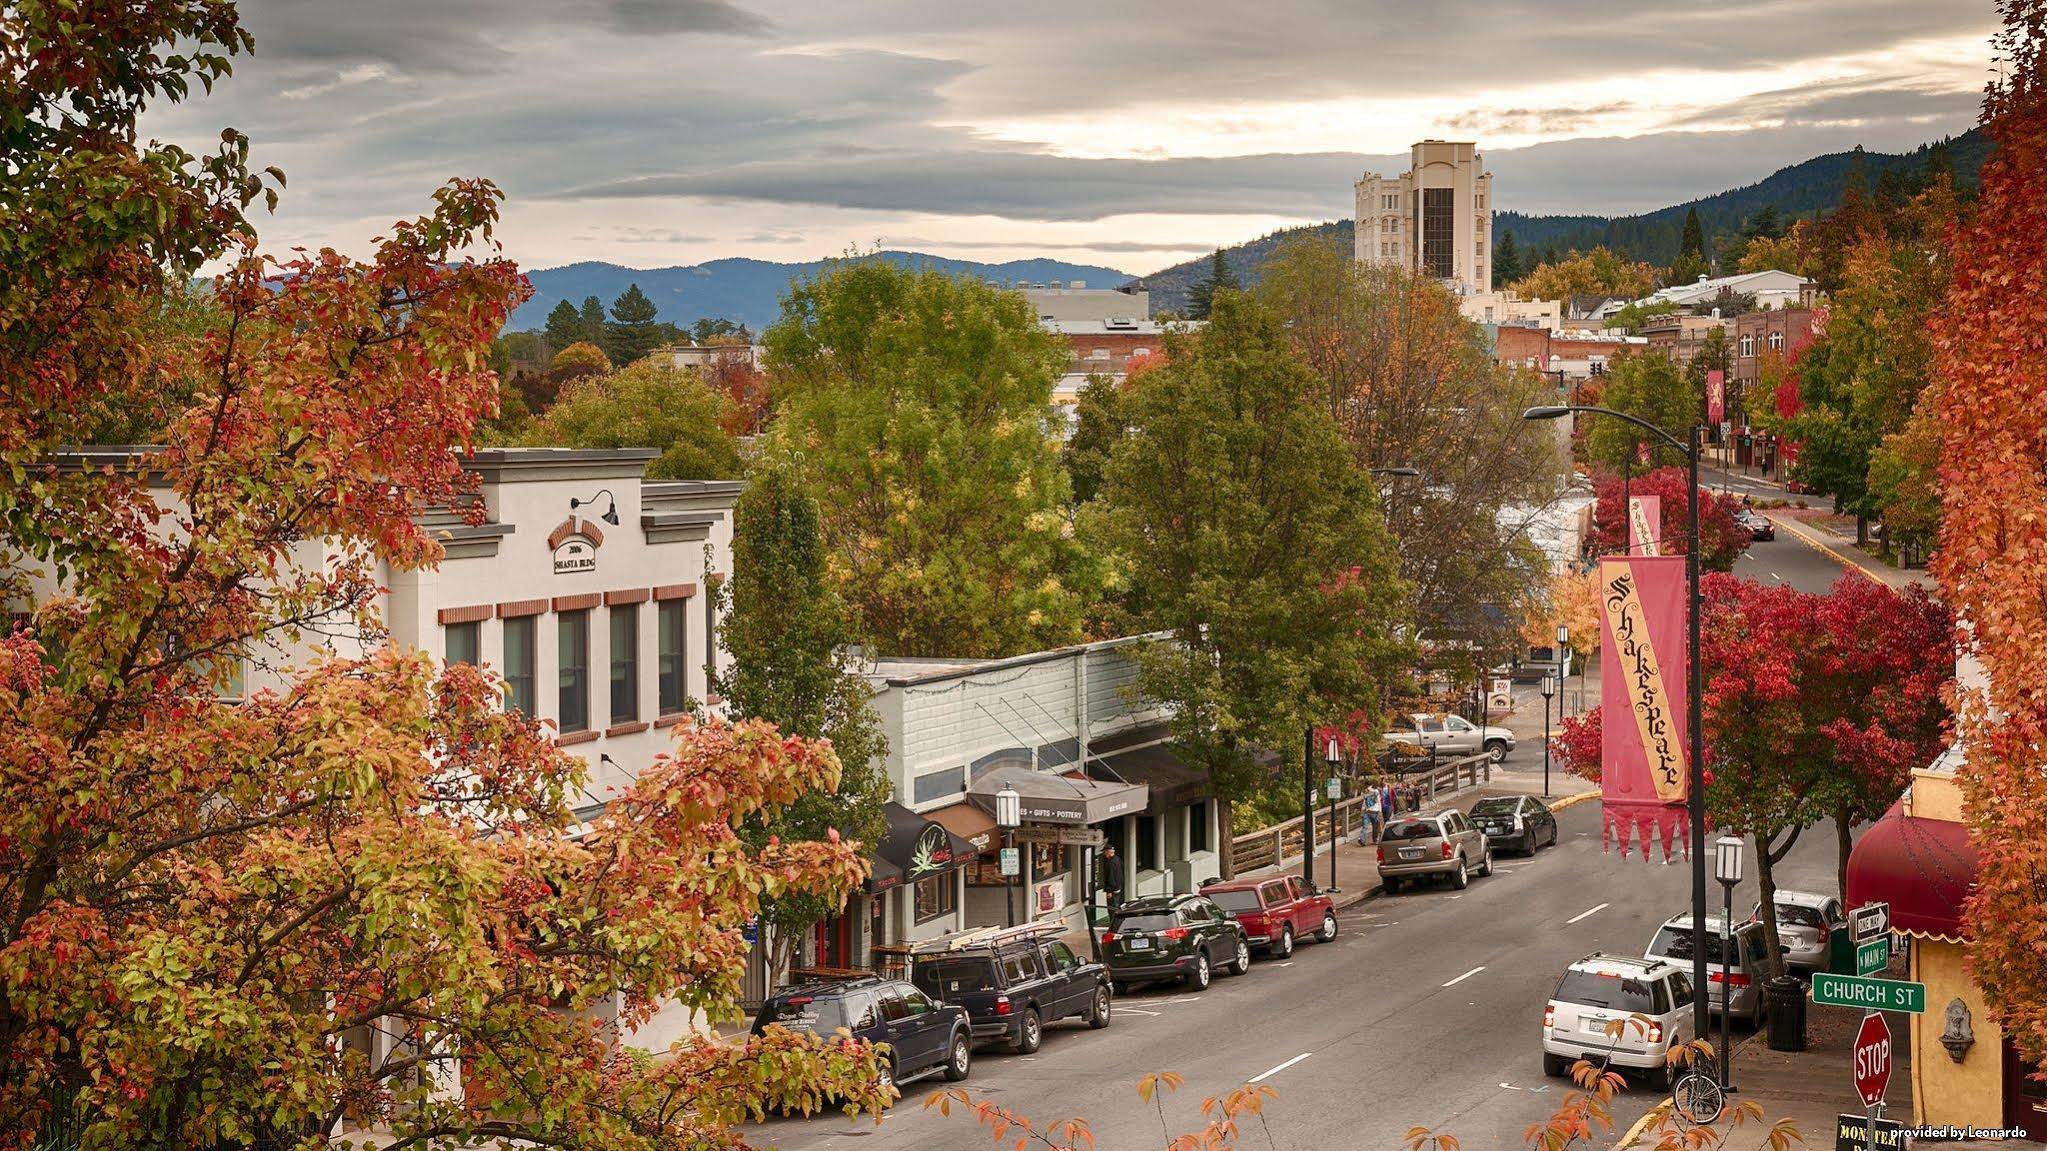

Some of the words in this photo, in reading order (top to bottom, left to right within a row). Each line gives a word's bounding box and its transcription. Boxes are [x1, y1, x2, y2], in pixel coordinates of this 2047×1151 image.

[555, 559, 578, 569] SHASTA
[579, 558, 595, 568] BLDG
[1602, 571, 1678, 787] Shakespeare
[1033, 809, 1051, 817] GIFTS
[1056, 810, 1083, 819] POTTERY
[1859, 917, 1870, 932] ONE
[1870, 914, 1880, 929] WAY
[1864, 947, 1880, 968] MAIN
[1880, 948, 1886, 961] ST
[1823, 981, 1886, 1003] CHURCH
[1895, 988, 1915, 1006] ST
[1857, 1038, 1889, 1080] STOP
[1839, 1124, 1897, 1147] MONTER
